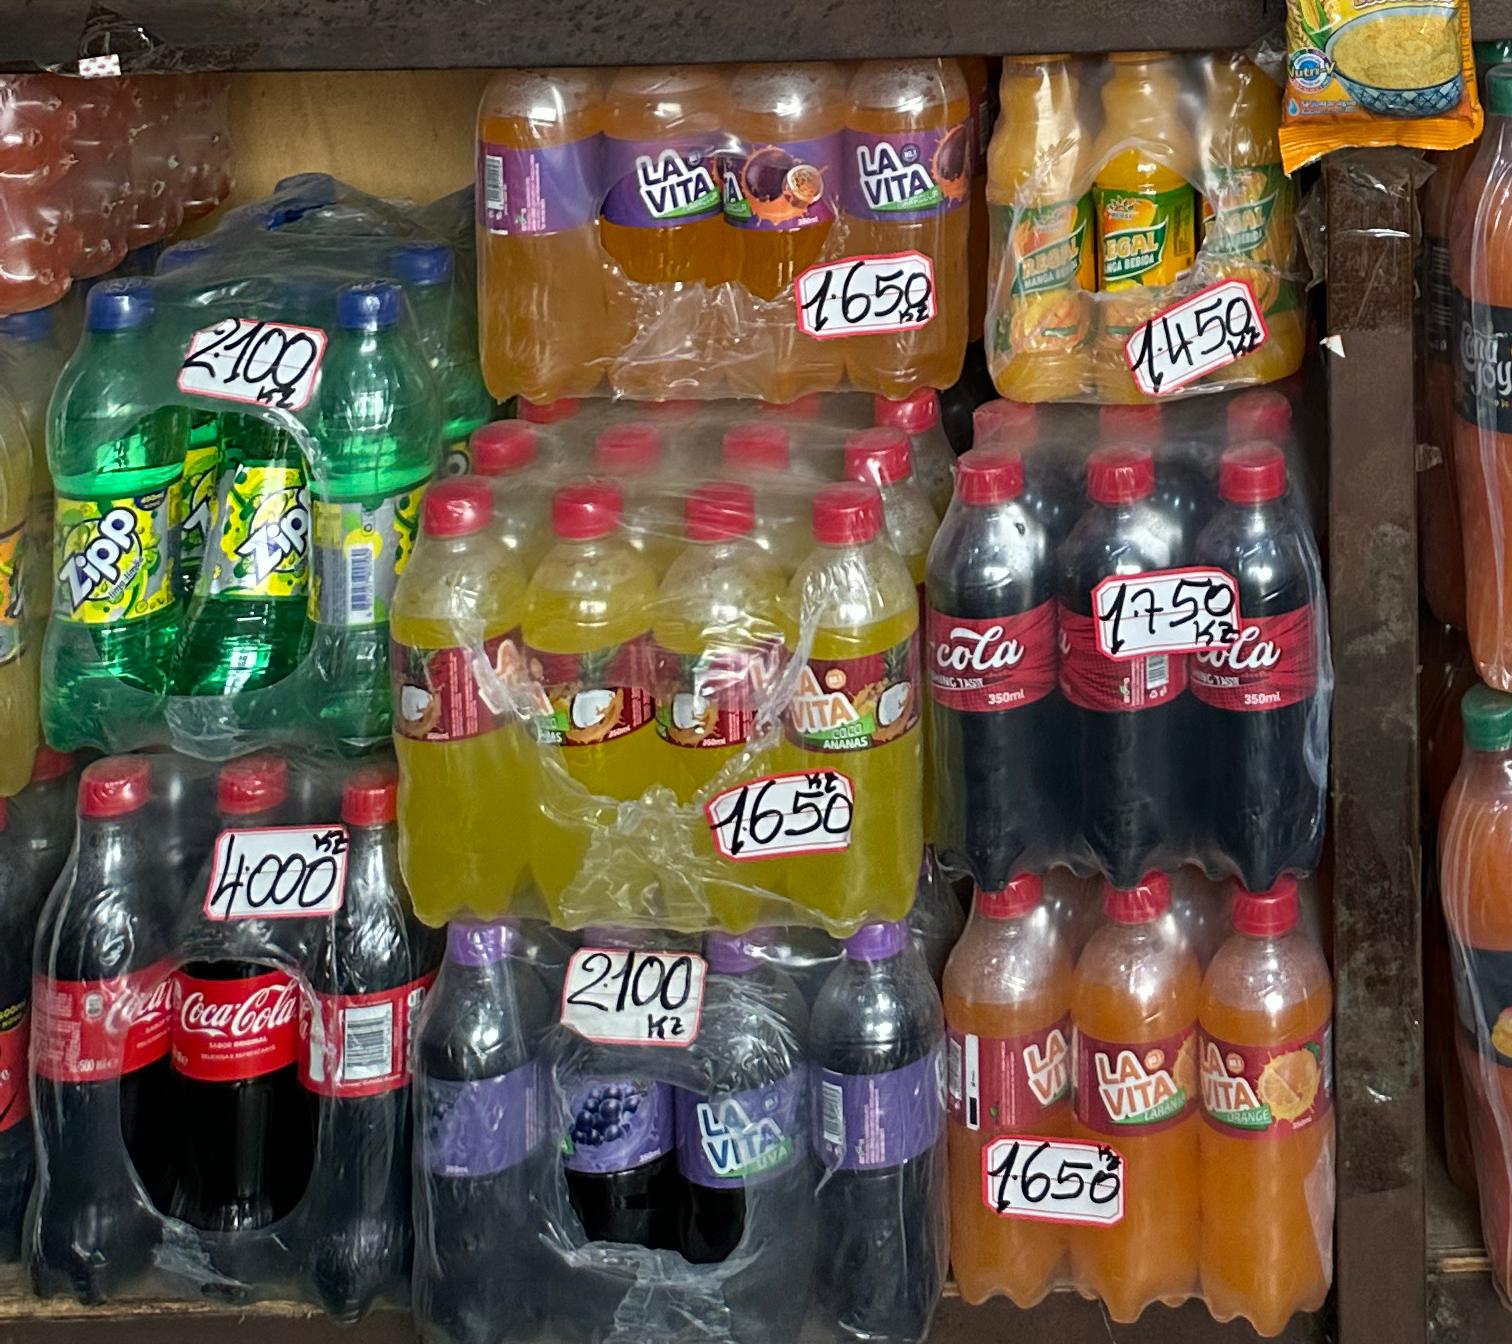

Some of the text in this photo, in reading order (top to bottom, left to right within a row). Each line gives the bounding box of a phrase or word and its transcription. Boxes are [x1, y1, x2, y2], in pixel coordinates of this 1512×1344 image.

[637, 153, 684, 187] LA
[856, 142, 899, 177] LA
[644, 178, 718, 214] VITA
[862, 168, 936, 207] VITA
[800, 261, 932, 331] 1.650
[182, 319, 319, 389] 2.100
[1130, 295, 1255, 395] 1.450
[57, 506, 139, 612] Zipp
[1097, 578, 1236, 654] 1.750
[986, 689, 1026, 705] 350ml
[1243, 691, 1282, 705] 350ml
[210, 833, 339, 921] 4.000
[565, 950, 692, 1012] 2.100
[180, 983, 297, 1038] Coca-Cola
[1098, 1052, 1136, 1087] LA
[1101, 1075, 1175, 1118] VITA
